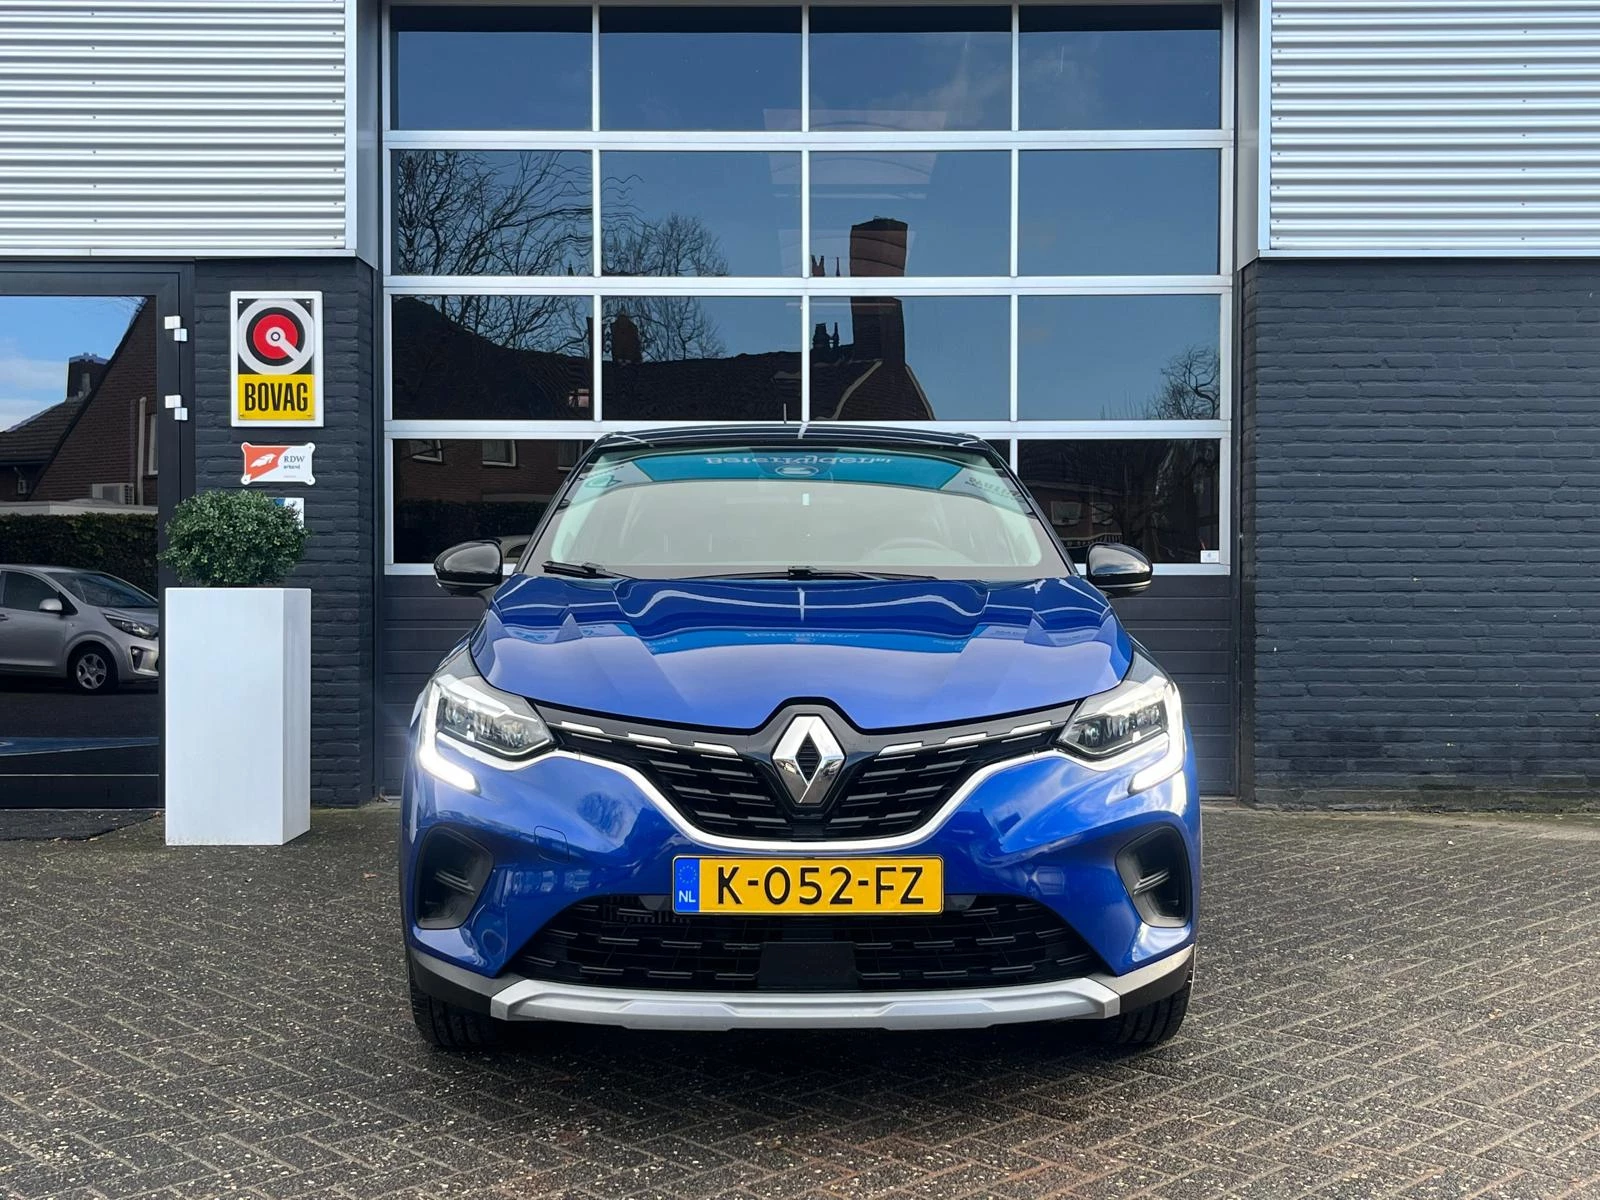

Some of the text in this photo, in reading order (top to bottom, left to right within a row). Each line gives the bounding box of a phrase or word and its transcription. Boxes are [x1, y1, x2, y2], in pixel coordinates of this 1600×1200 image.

[244, 382, 308, 412] BOVAG
[283, 455, 305, 463] RDW
[717, 866, 924, 905] K-052-FZ
[678, 890, 696, 903] NL
